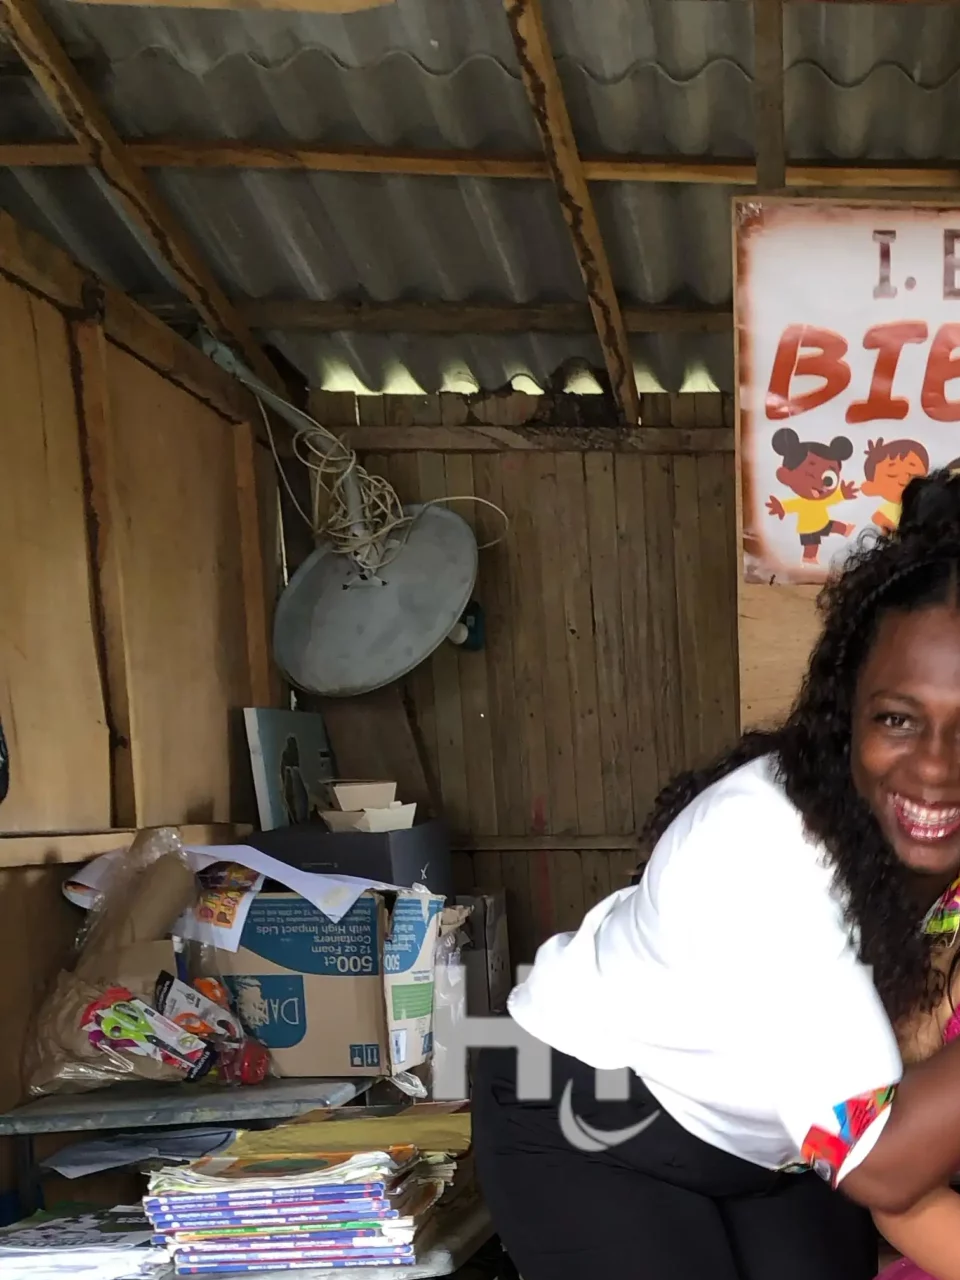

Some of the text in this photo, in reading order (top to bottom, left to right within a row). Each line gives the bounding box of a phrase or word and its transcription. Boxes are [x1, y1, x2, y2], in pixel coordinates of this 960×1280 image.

[872, 228, 917, 300] I.
[256, 923, 371, 935] with High Impact Lids
[313, 934, 371, 943] Containers
[311, 945, 372, 954] 12 oz Foam
